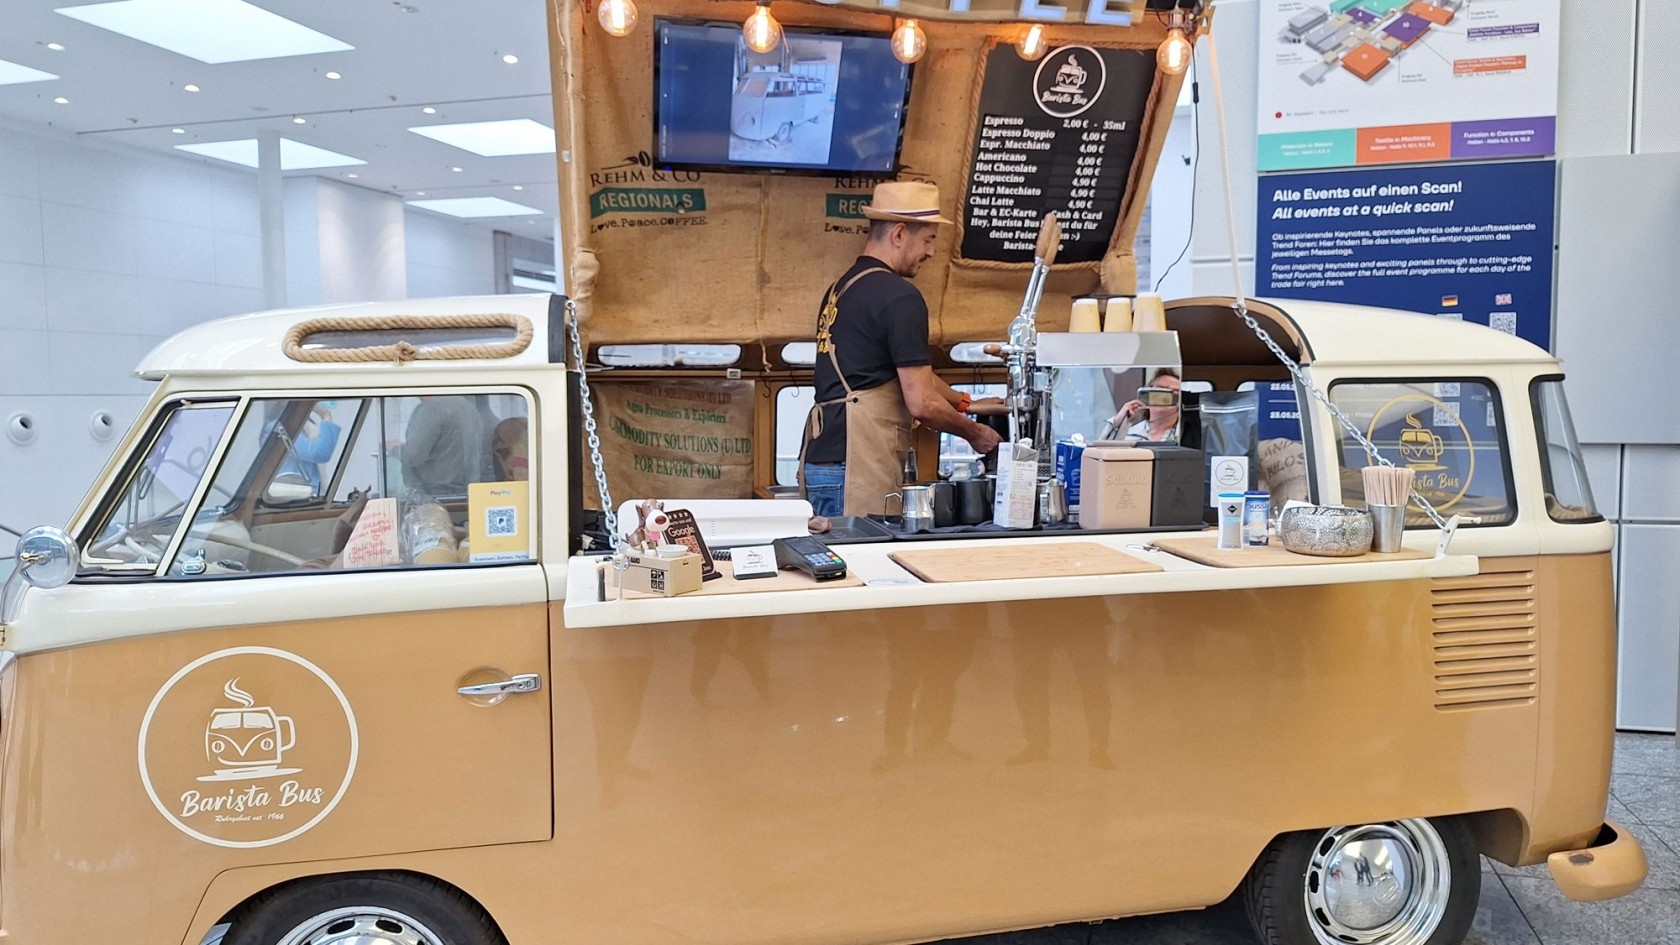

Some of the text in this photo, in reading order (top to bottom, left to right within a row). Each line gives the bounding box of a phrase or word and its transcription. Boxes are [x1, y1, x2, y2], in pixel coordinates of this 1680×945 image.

[1042, 91, 1072, 104] Barista
[984, 116, 1024, 126] Espresso
[1063, 119, 1082, 129] 2,00
[1082, 120, 1089, 129] €
[1102, 120, 1127, 130] 35ml
[982, 128, 1107, 142] Espresso Doppio 4,00 €
[979, 140, 1105, 154] Espr. Macchiato 4,00 €
[977, 152, 1102, 166] Americano 4,00 €
[975, 162, 1100, 177] Hot Chocolate 4,00 €
[590, 170, 700, 188] REHM & CO
[973, 173, 1097, 187] Cappuccino 4,90 €
[971, 185, 1095, 198] Latte Macchiato 4,90 €
[1273, 181, 1462, 202] Alle Events auf einen Scan!
[969, 196, 1093, 210] Chai Latte 4,90 €
[1272, 199, 1455, 220] All events at a quick scan!
[973, 207, 989, 216] Bar
[990, 208, 998, 216] &
[999, 208, 1037, 218] EC-Karte
[1072, 211, 1080, 220] &
[1081, 211, 1103, 220] Card
[970, 217, 990, 228] Hey,
[991, 218, 1022, 228] Barista
[1023, 218, 1039, 228] Bus
[1070, 220, 1084, 230] du
[1085, 220, 1098, 230] für
[989, 230, 1014, 239] deine
[1014, 231, 1037, 240] Feier
[1272, 223, 1536, 241] Ob inspirierende Keynotes, spannende Panels oder zukunftsweisende
[1272, 241, 1293, 249] Trend
[1319, 239, 1335, 247] Hier
[1336, 238, 1360, 247] finden
[1361, 237, 1373, 246] Sie
[1375, 237, 1389, 245] das
[1390, 235, 1430, 245] komplette
[1431, 233, 1494, 243] Eventprogramm
[1495, 233, 1511, 241] des
[1271, 250, 1309, 259] jeweiligen
[1271, 263, 1290, 271] From
[1292, 262, 1323, 272] inspiring
[1325, 261, 1359, 271] keynotes
[1360, 260, 1376, 268] and
[1376, 259, 1407, 268] exciting
[1408, 258, 1434, 267] panels
[1436, 256, 1467, 266] through
[1478, 255, 1533, 265] cutting-edge
[1272, 272, 1292, 280] Trend
[1293, 271, 1324, 279] Forums,
[1324, 270, 1356, 278] discover
[1357, 269, 1371, 277] the
[1372, 268, 1385, 276] full
[1386, 268, 1408, 276] event
[1409, 267, 1455, 276] programme
[1468, 265, 1489, 273] each
[1490, 265, 1506, 274] day
[1507, 264, 1517, 272] of
[1517, 264, 1531, 272] the
[1271, 280, 1291, 288] trade
[1292, 280, 1306, 288] fair
[1306, 279, 1325, 289] right
[645, 403, 682, 419] Processors
[684, 408, 690, 419] &
[692, 409, 727, 424] Exporters
[664, 433, 719, 453] SOLUTIONS
[735, 437, 752, 454] LTD
[634, 454, 722, 480] FOR EXPORT ONLY
[1438, 472, 1459, 489] Bus
[667, 525, 696, 537] Google
[180, 780, 325, 817] Barista Bus
